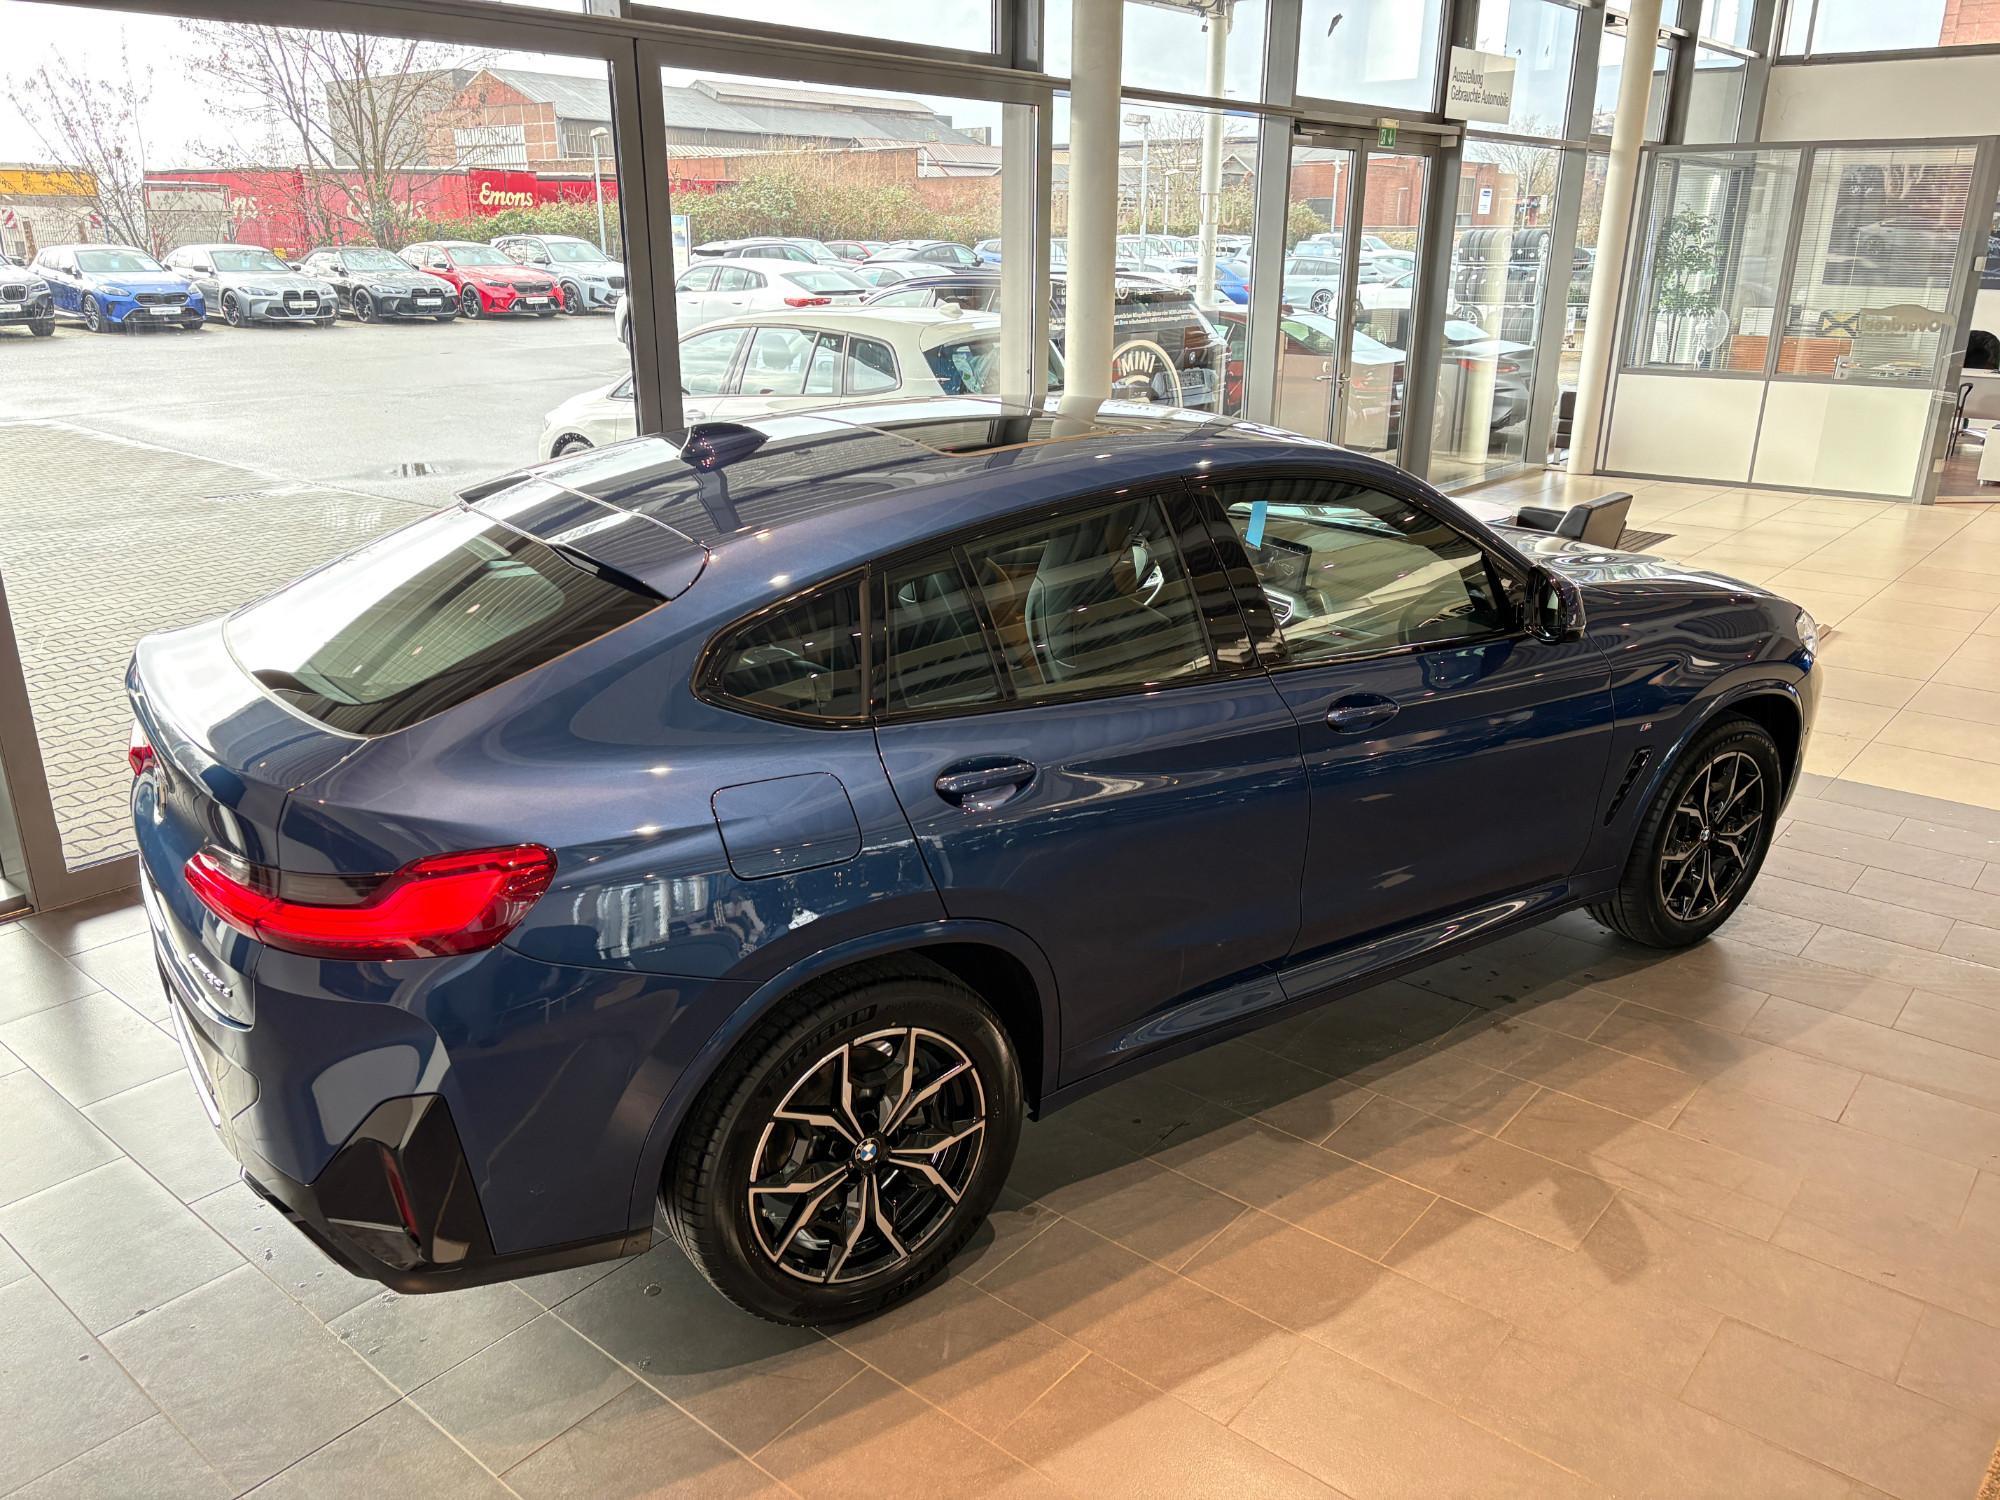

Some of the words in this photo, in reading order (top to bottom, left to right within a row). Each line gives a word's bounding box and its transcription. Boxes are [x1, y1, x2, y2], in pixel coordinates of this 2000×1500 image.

[1452, 66, 1484, 88] Ausstellung
[1451, 84, 1481, 104] Gebrauchte
[1482, 89, 1509, 107] Automobile
[479, 182, 533, 207] Emons
[1121, 351, 1156, 376] MINI
